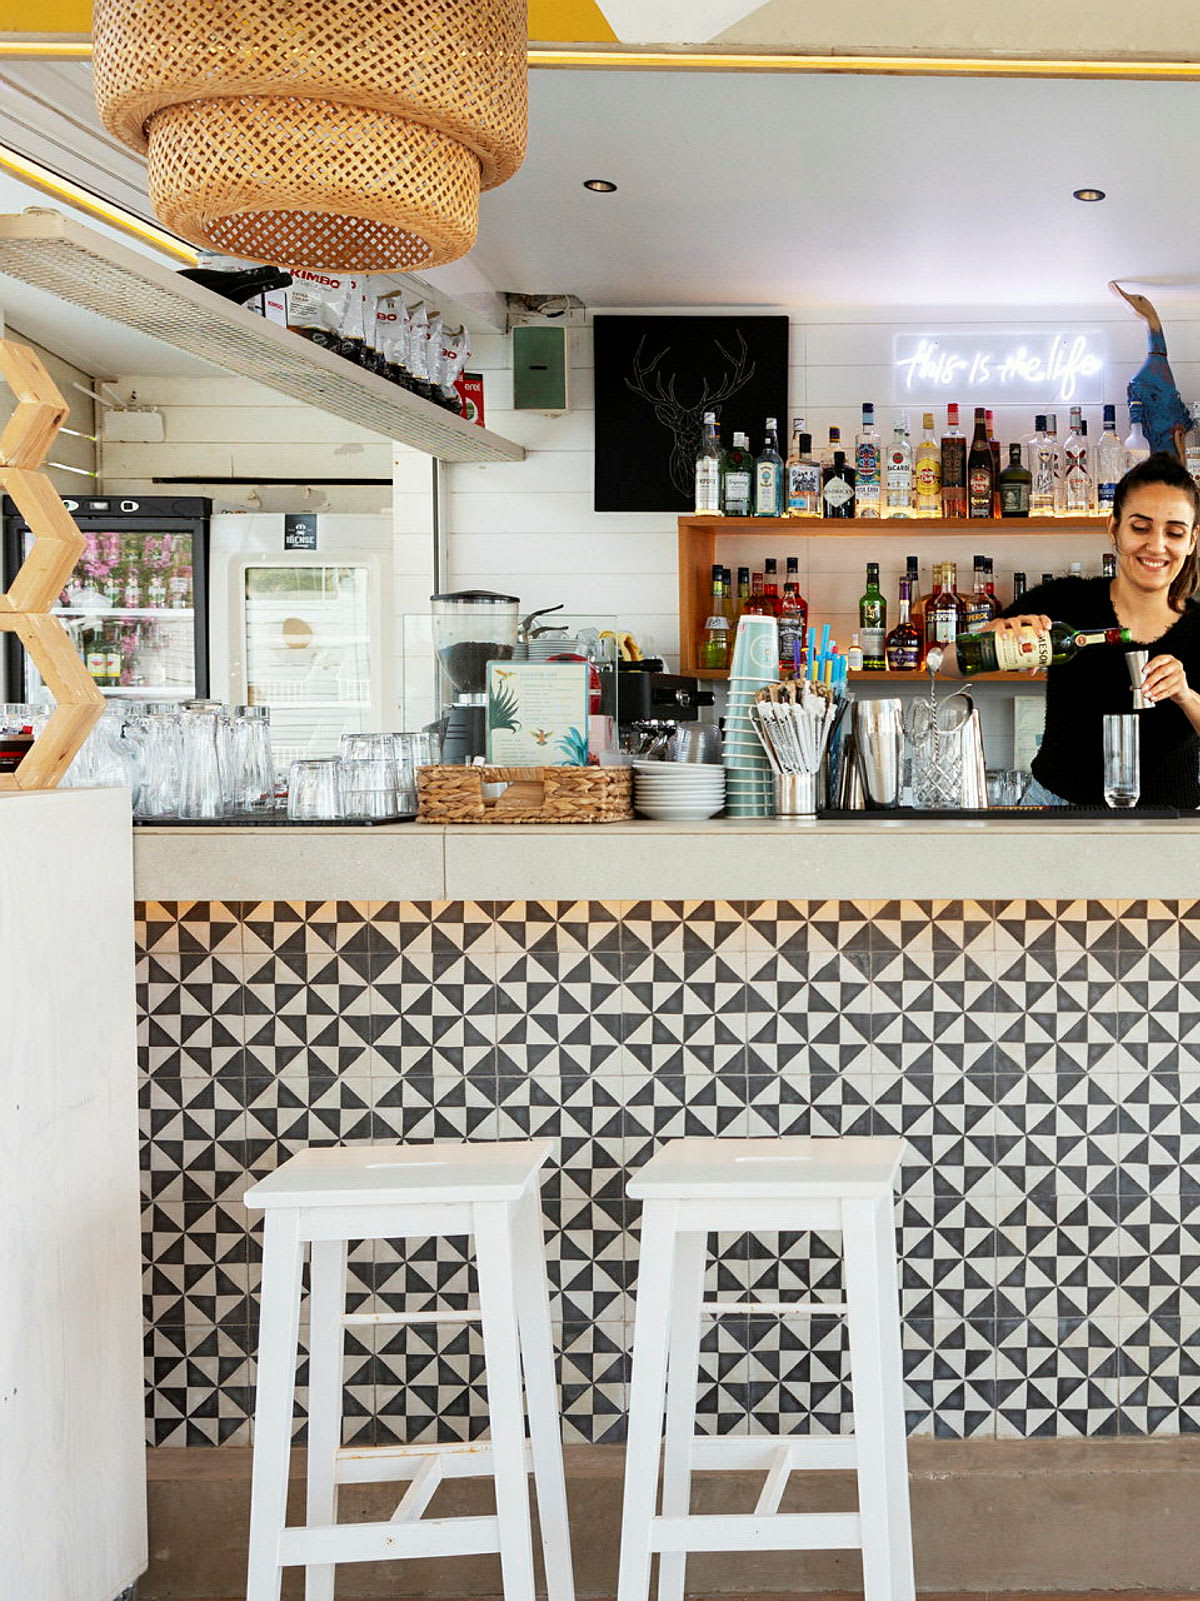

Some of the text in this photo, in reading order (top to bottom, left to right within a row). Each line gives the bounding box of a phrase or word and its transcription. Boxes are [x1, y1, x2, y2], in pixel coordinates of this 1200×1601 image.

[289, 268, 341, 289] KIMBO
[969, 352, 990, 383] is
[1046, 334, 1103, 400] life
